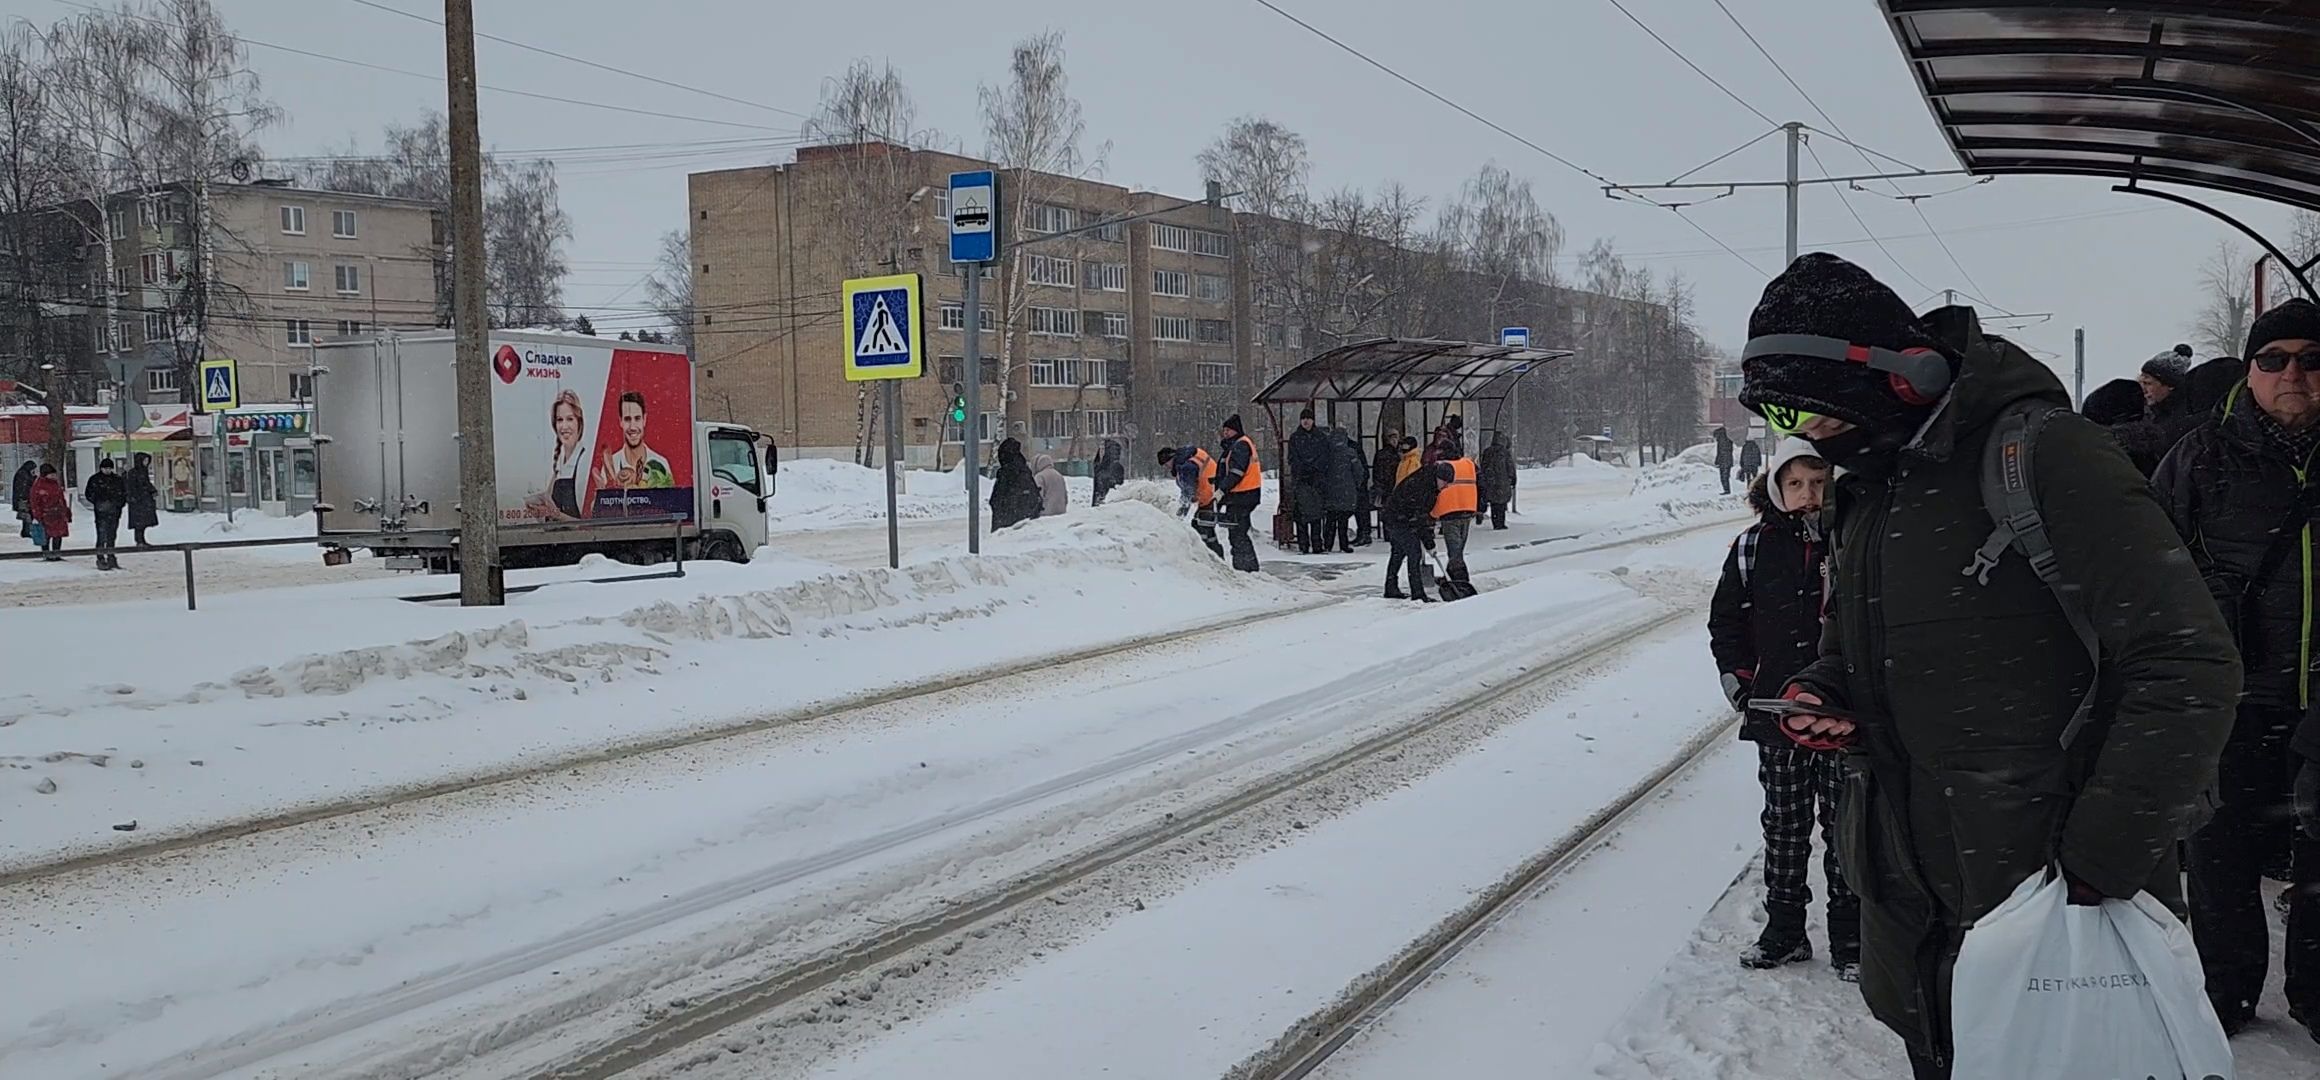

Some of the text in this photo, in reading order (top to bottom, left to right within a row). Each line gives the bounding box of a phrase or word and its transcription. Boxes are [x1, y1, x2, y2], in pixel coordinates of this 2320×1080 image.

[525, 350, 573, 366] Сладкая
[527, 368, 561, 379] жизнь
[600, 496, 652, 507] партнрство,
